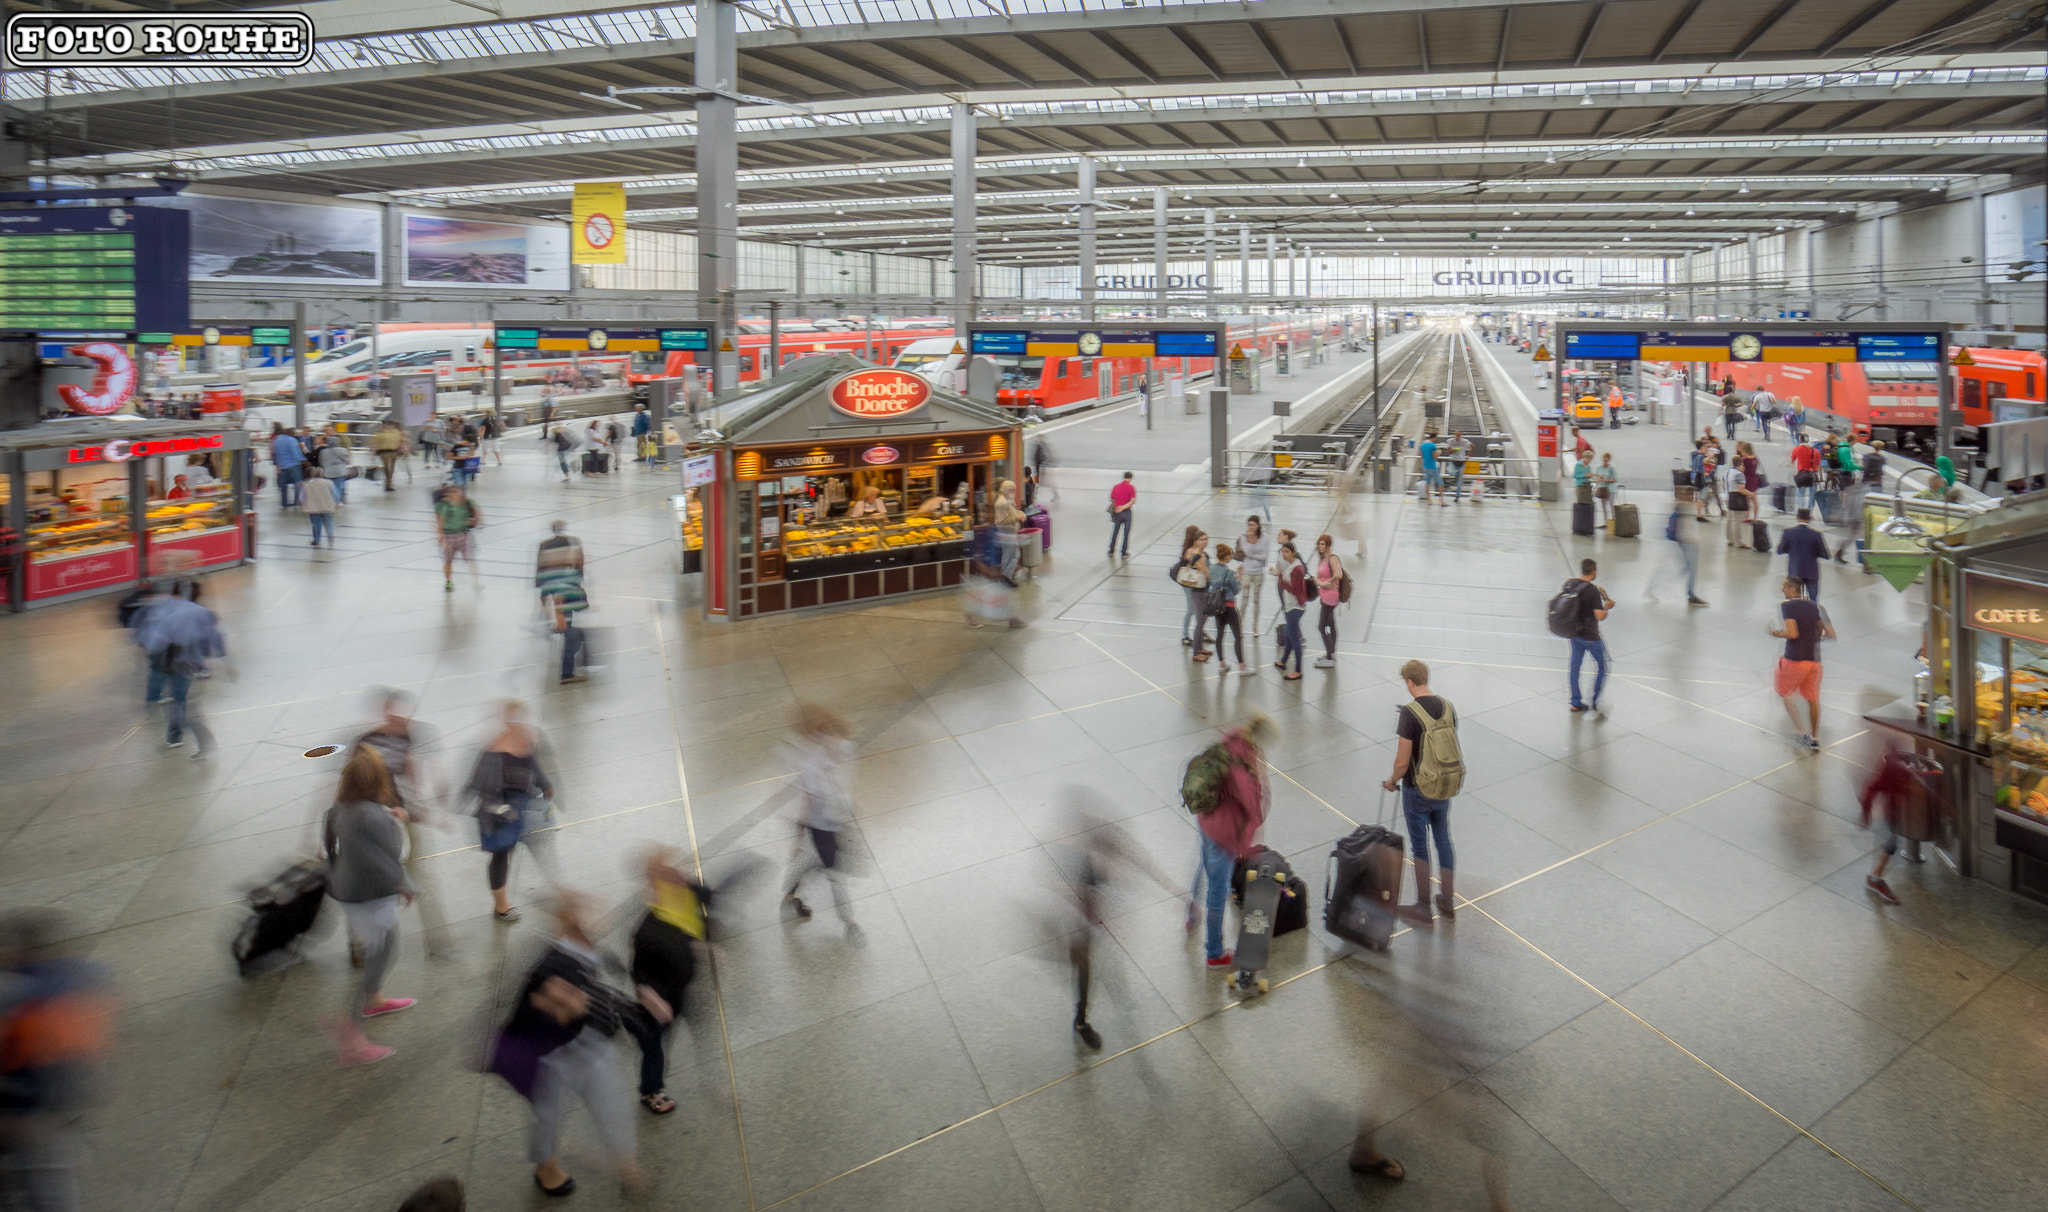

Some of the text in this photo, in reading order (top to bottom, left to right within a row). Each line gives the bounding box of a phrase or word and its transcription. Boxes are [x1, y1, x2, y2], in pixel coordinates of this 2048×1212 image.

[1432, 270, 1574, 286] GRUNDIG
[845, 377, 919, 397] Brioche
[855, 395, 909, 413] Dorée
[67, 446, 104, 463] LE
[773, 455, 835, 468] SANDWICH
